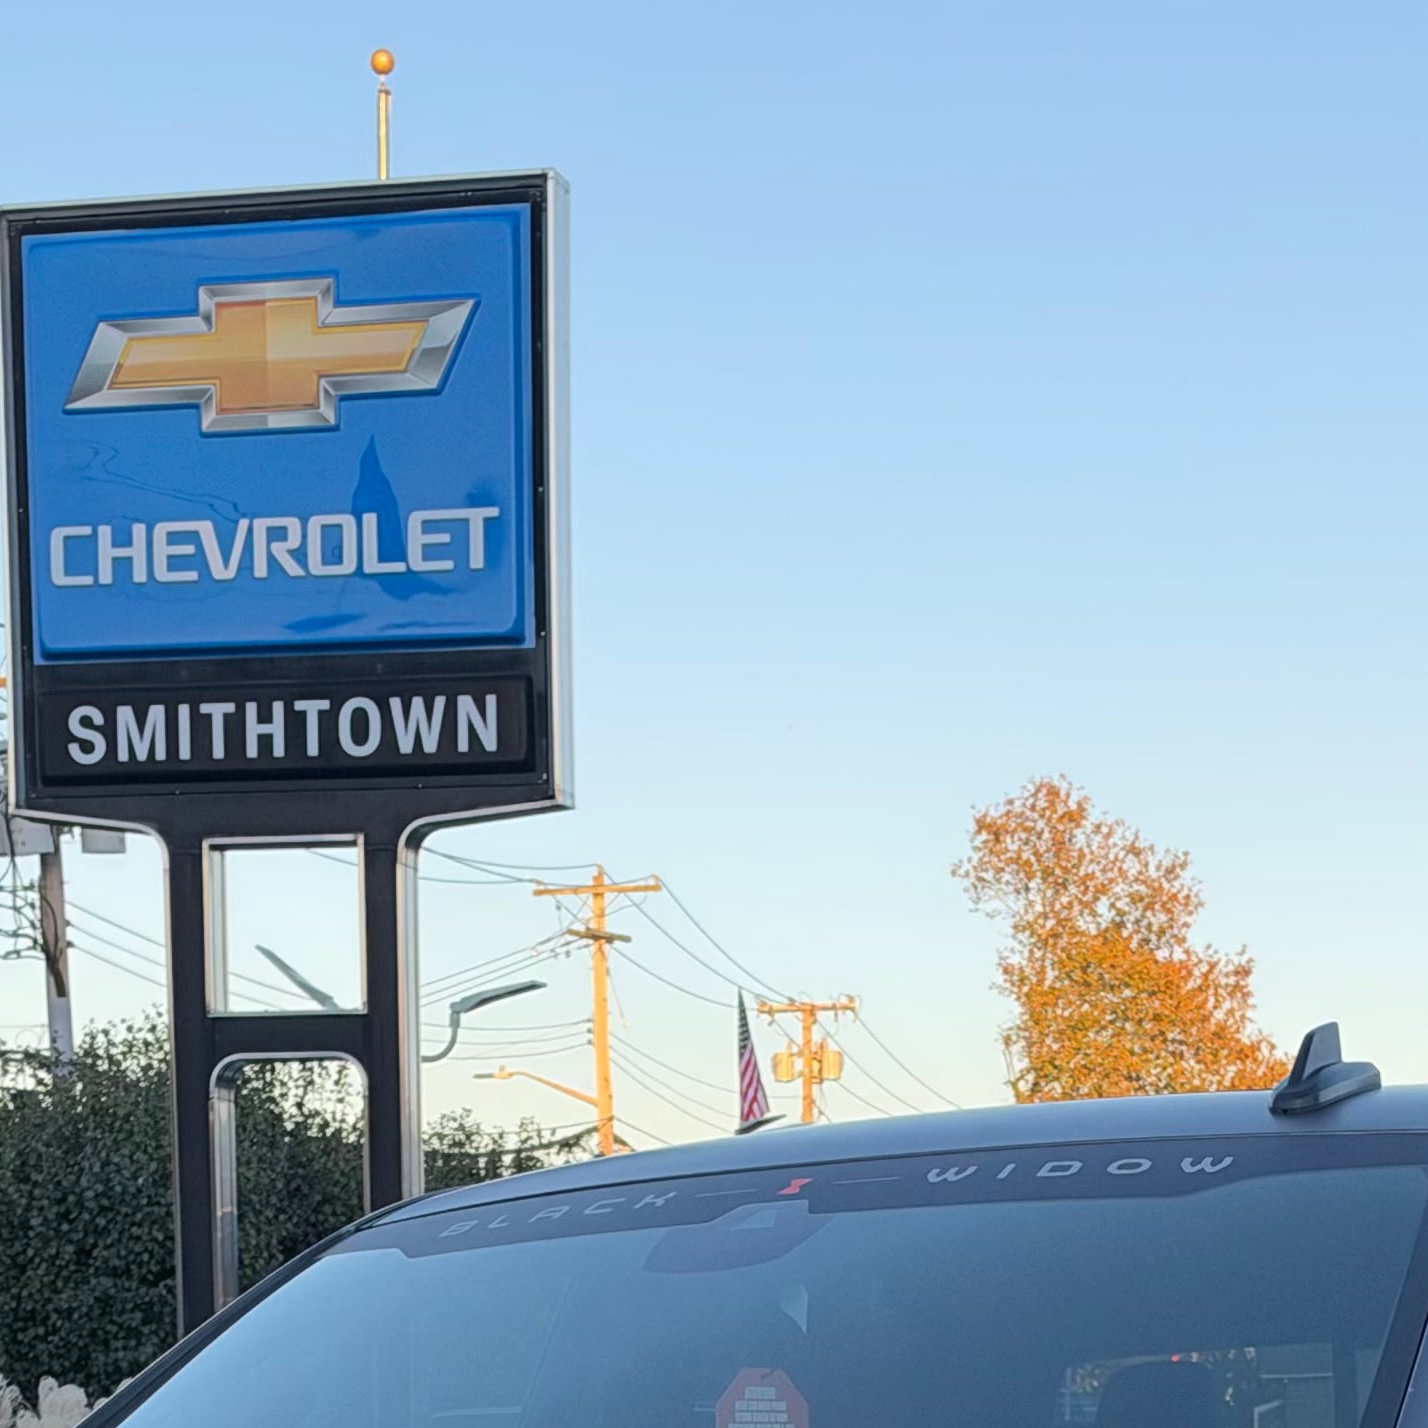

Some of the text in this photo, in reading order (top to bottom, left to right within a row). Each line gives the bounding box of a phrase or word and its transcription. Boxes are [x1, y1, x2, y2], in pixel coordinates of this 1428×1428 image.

[50, 507, 500, 587] CHEVROLET
[66, 693, 500, 766] SMITHTOWN
[438, 1155, 1236, 1239] BLACK WIDOW
